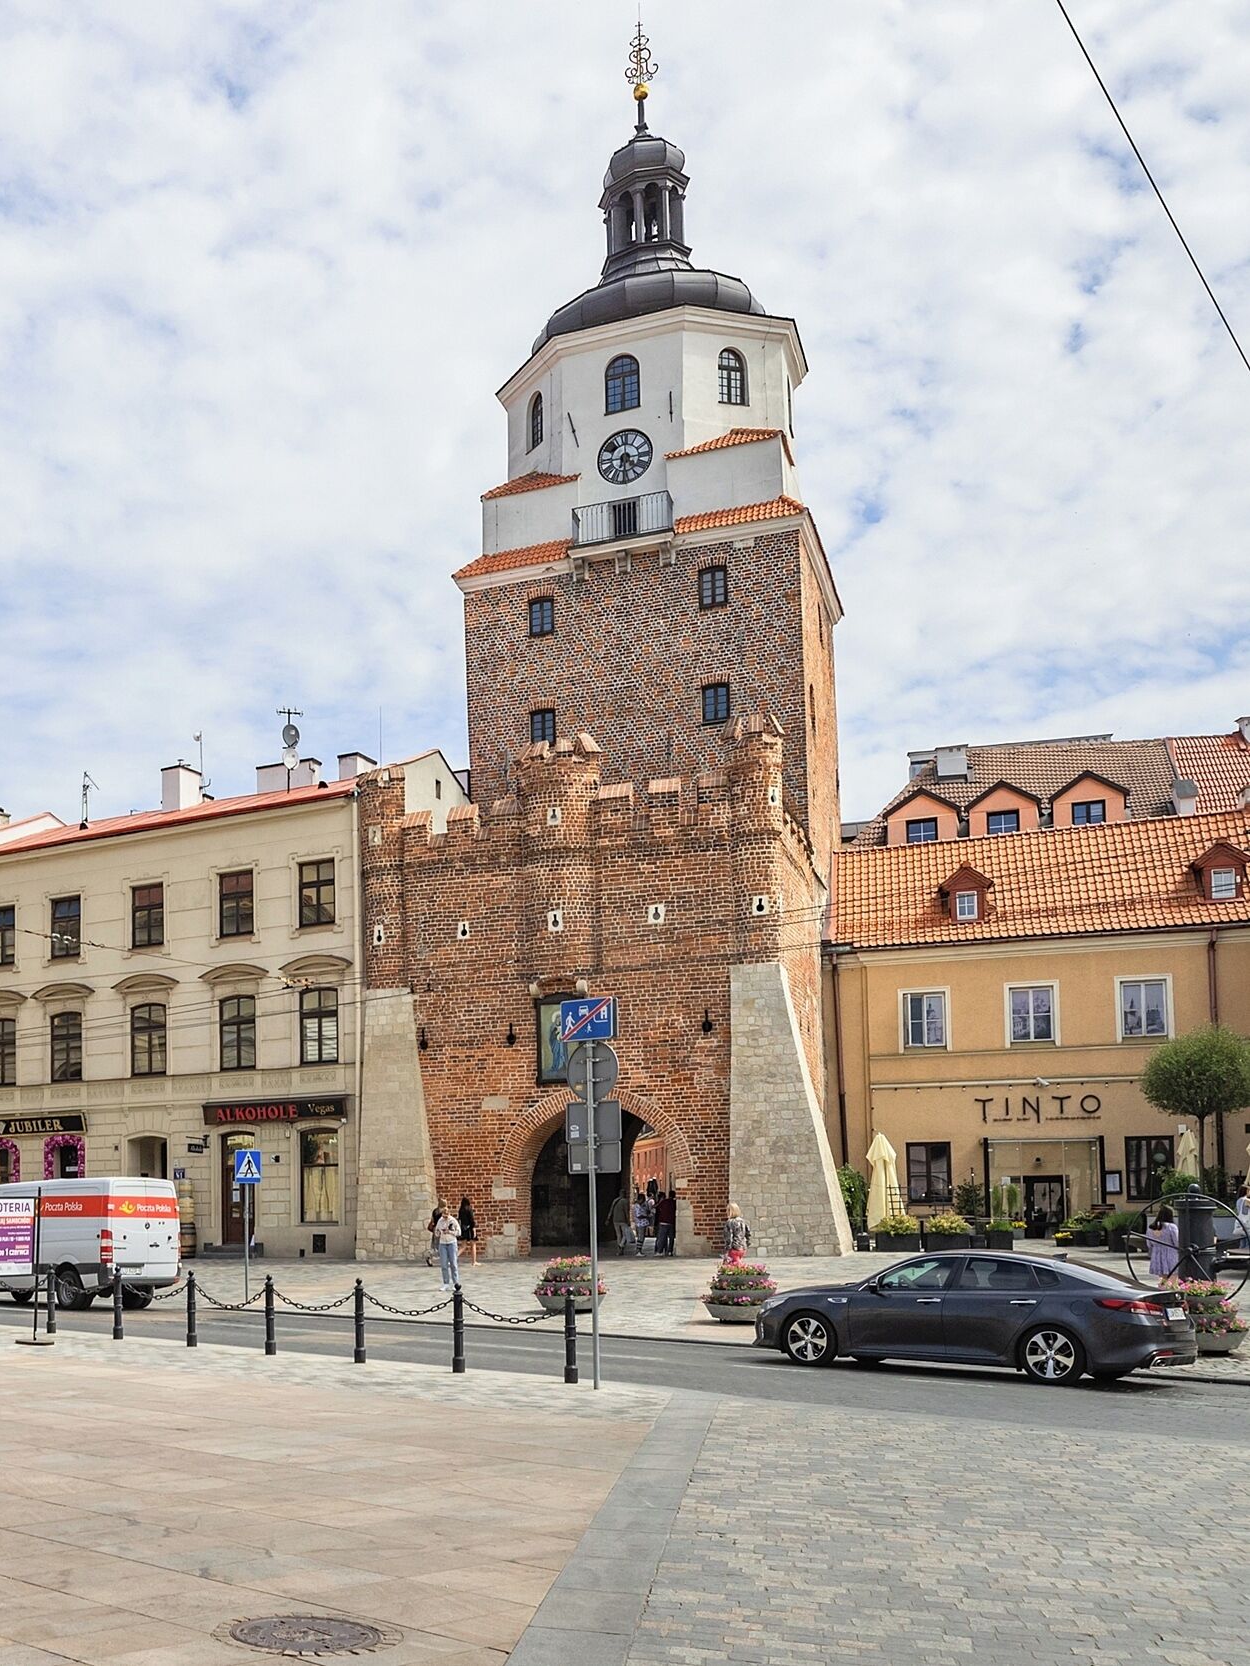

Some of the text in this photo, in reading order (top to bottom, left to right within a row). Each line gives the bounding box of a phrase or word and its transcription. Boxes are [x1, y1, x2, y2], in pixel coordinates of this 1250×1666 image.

[216, 1103, 335, 1121] ALKOHOLE Vegas
[974, 1094, 1101, 1124] TINTO
[8, 1119, 64, 1133] JUBILER
[44, 1202, 83, 1212] Poczta Polska
[136, 1203, 172, 1212] Poczta Polska
